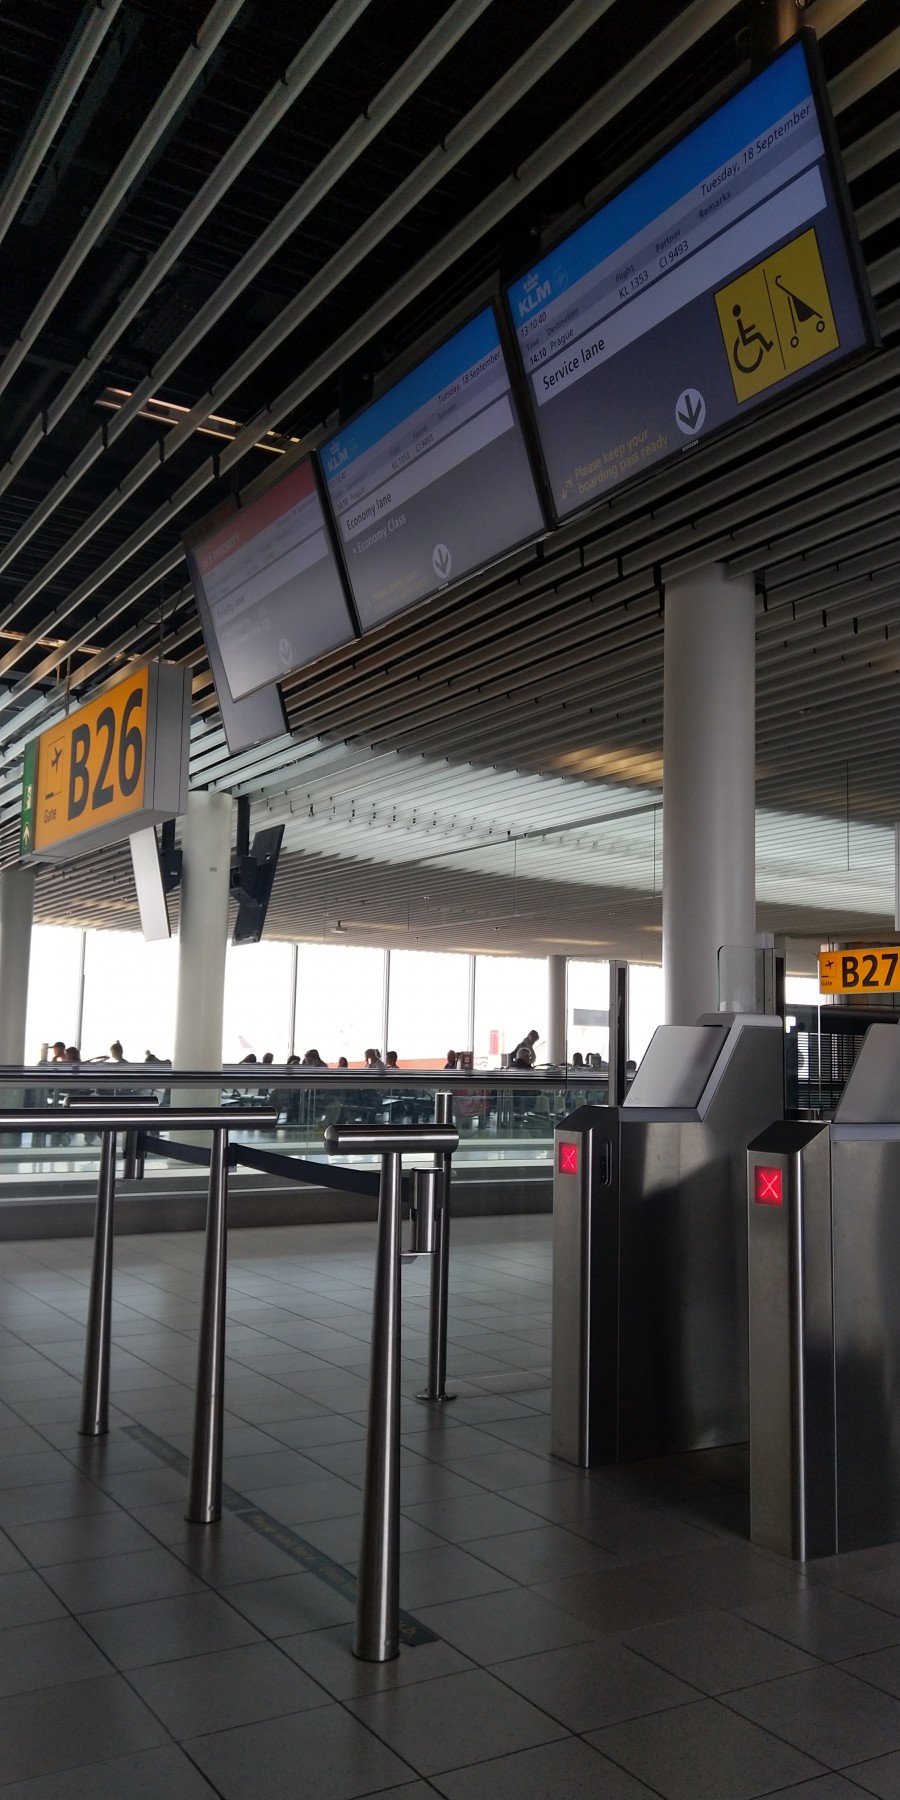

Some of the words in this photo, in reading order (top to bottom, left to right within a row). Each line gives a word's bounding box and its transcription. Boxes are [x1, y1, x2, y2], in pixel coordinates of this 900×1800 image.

[701, 162, 740, 196] Tuesday,
[743, 147, 754, 163] 18
[756, 105, 810, 153] September
[546, 307, 580, 336] Destination
[616, 264, 634, 284] Flight
[655, 229, 681, 253] Partner
[698, 191, 731, 219] Remarks
[518, 280, 552, 317] KLM
[530, 347, 547, 366] 14:10
[550, 329, 574, 350] Prague
[619, 286, 629, 299] KL
[631, 270, 649, 290] 1353
[669, 240, 689, 262] 9493
[521, 311, 547, 338] 13:10:40
[438, 384, 462, 403] Tuesday,
[462, 375, 470, 385] 18
[469, 352, 500, 380] September
[543, 358, 579, 390] Service
[581, 339, 605, 363] lane
[326, 448, 349, 472] KLM
[574, 457, 602, 481] Please
[602, 443, 627, 463] keep
[627, 430, 649, 458] your
[577, 462, 619, 495] boarding
[619, 453, 641, 482] pass
[641, 434, 669, 464] ready
[346, 504, 377, 531] Economy
[376, 494, 392, 510] lane
[357, 527, 389, 553] Economy
[387, 514, 407, 532] Class
[68, 688, 143, 821] B26
[43, 809, 57, 823] Gate
[842, 953, 898, 988] B27
